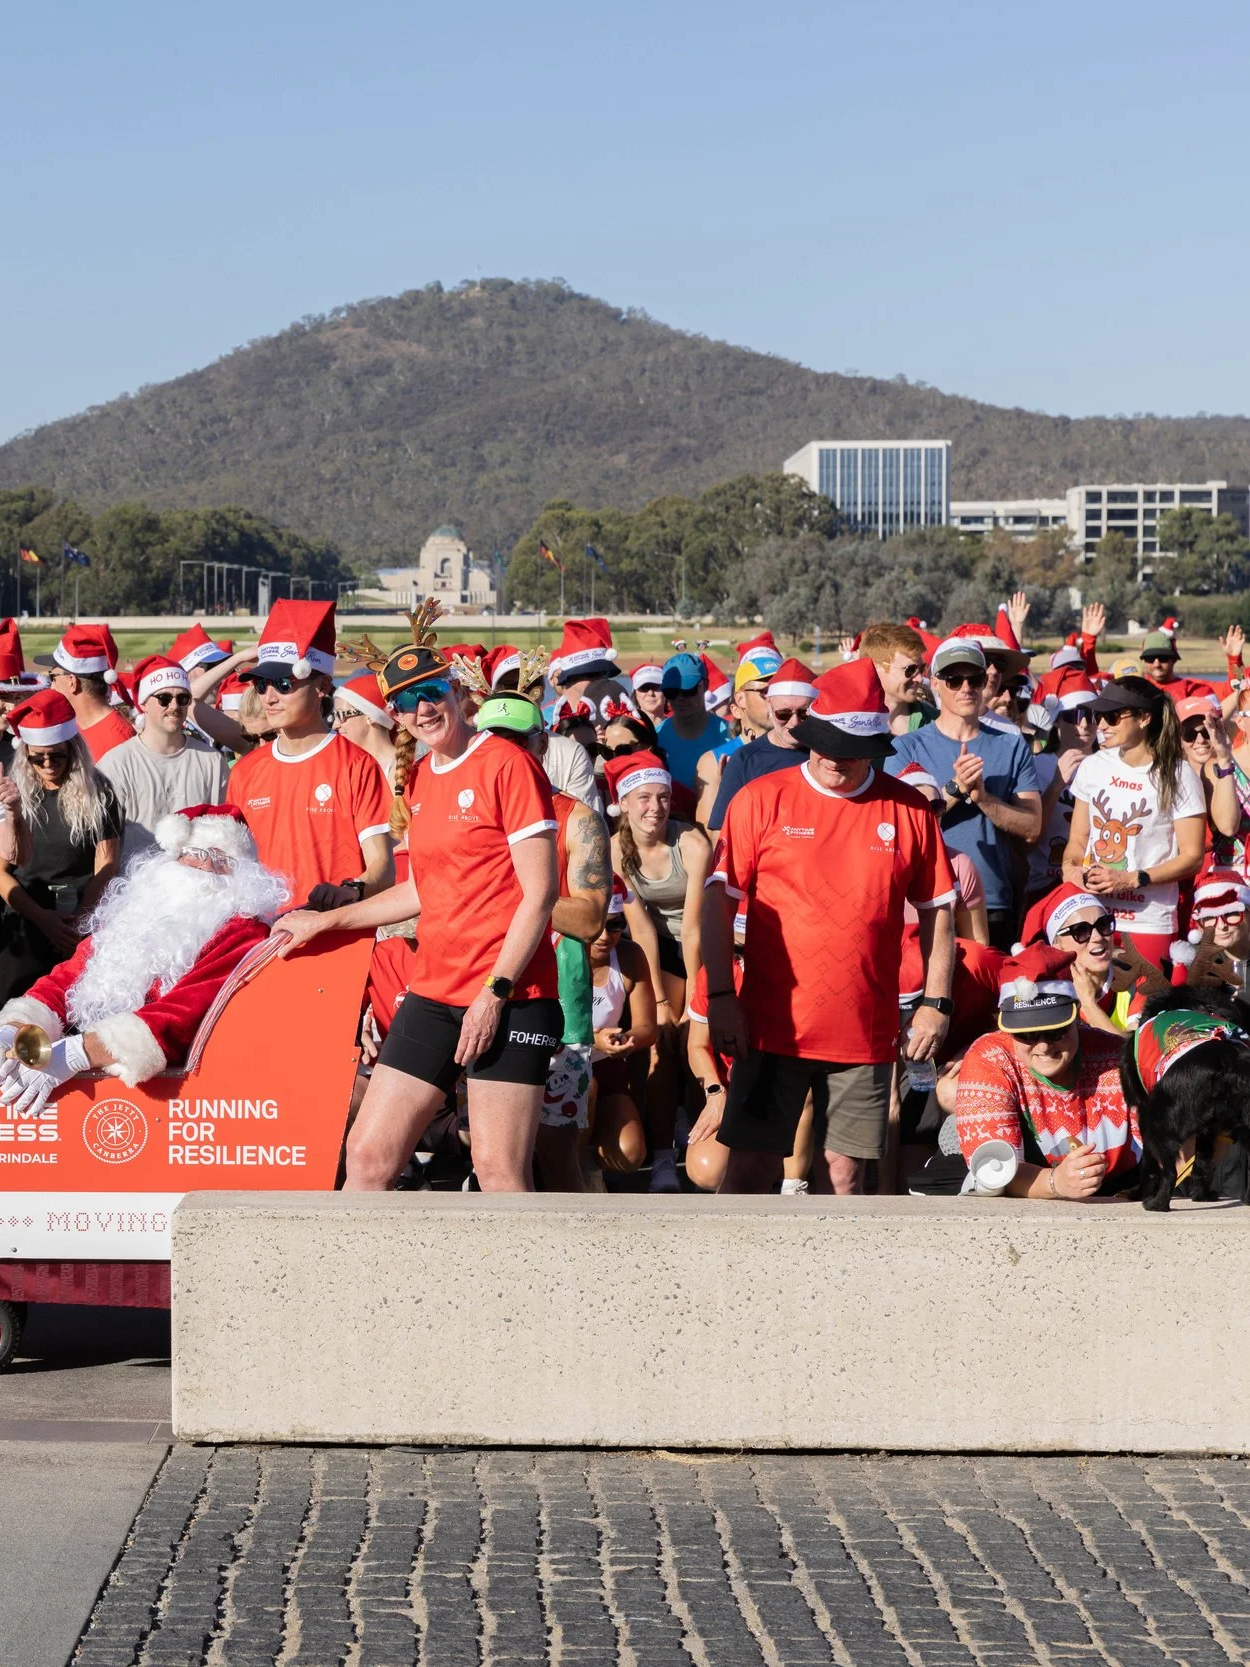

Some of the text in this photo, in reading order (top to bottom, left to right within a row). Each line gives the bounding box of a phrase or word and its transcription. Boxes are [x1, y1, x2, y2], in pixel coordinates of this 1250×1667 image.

[150, 673, 163, 685] HO
[166, 672, 181, 680] HO
[1109, 775, 1143, 791] Xmas
[92, 1103, 140, 1120] THE JETTY
[168, 1098, 278, 1119] RUNNING
[168, 1121, 216, 1142] FOR
[93, 1142, 140, 1159] CANBERRA
[168, 1145, 307, 1166] RESILIENCE
[47, 1211, 168, 1233] MOVING
